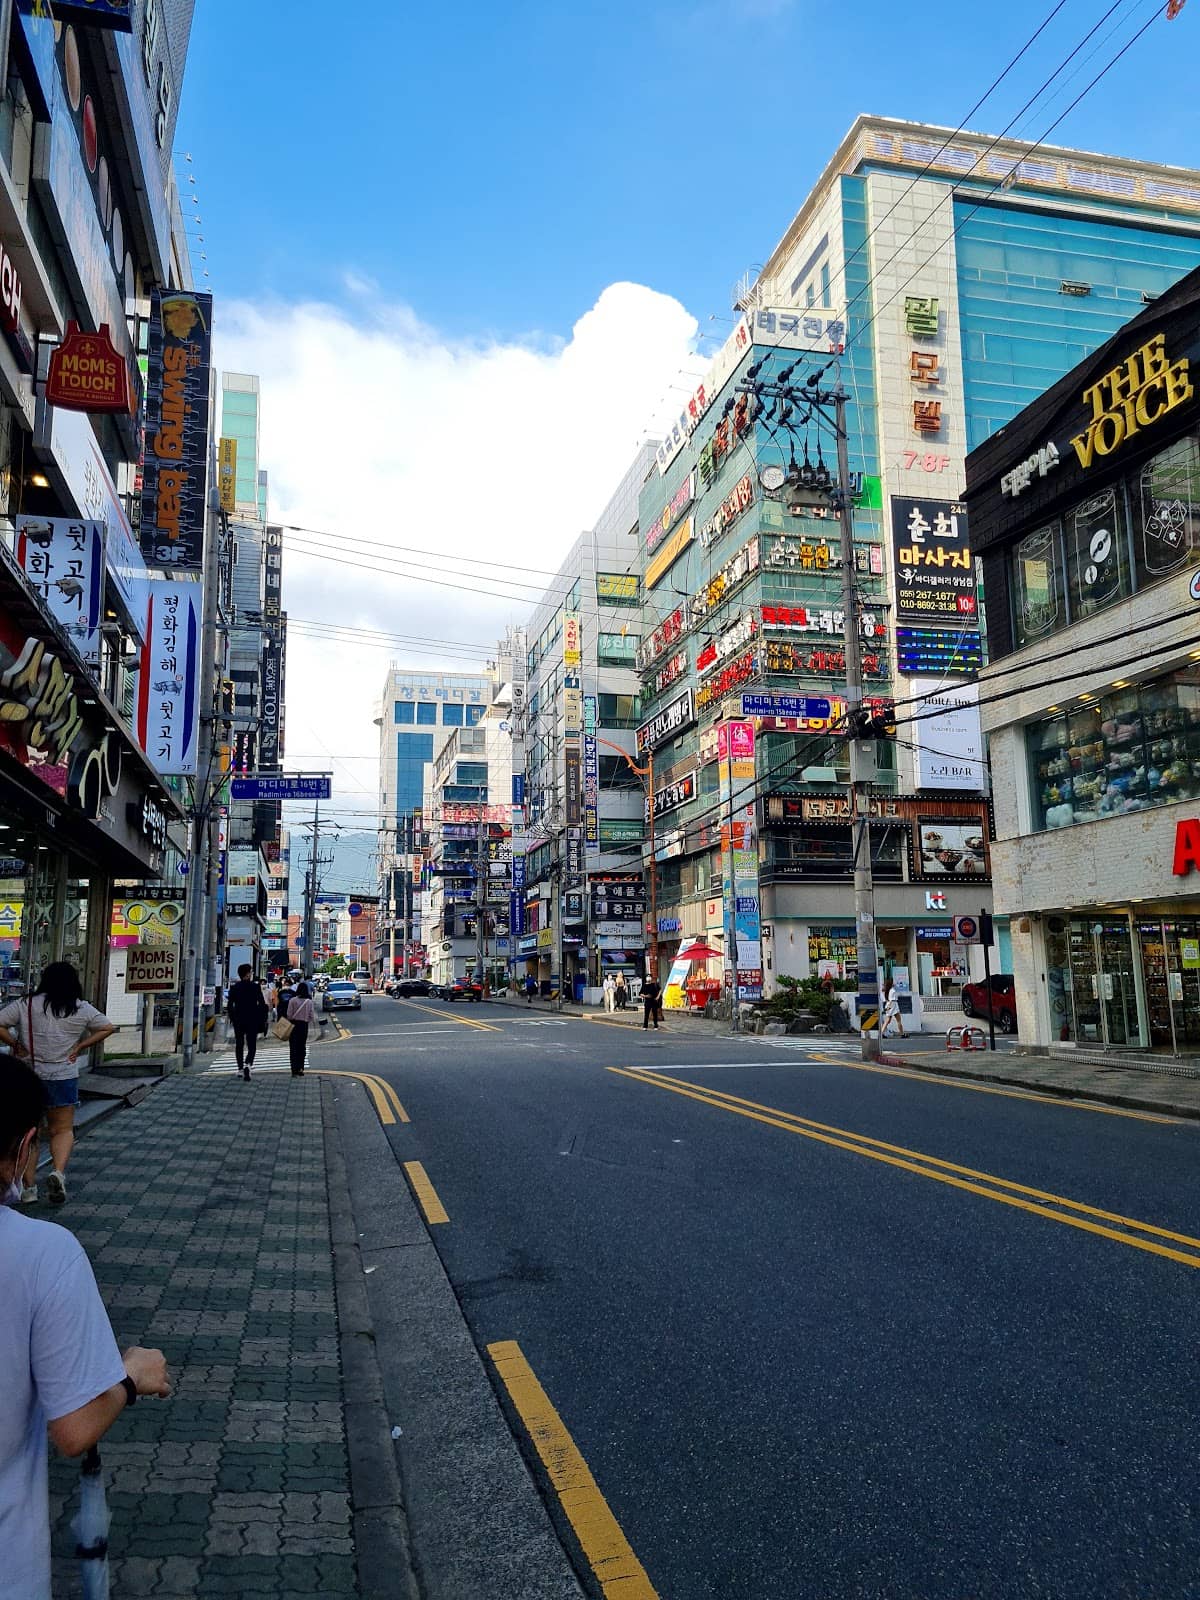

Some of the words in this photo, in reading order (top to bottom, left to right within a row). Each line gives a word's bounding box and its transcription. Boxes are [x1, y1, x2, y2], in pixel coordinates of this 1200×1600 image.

[0, 253, 22, 329] CH
[58, 371, 115, 392] TOUCH
[1083, 333, 1169, 425] THE
[153, 346, 193, 461] swing
[1069, 357, 1194, 469] VOICE
[157, 469, 189, 541] bar
[907, 507, 960, 543] 춘희
[156, 545, 187, 562] 3F
[899, 545, 971, 569] 마사지
[160, 595, 179, 676] 평화김해
[265, 658, 275, 691] ESCAPE
[264, 692, 277, 725] TOP
[157, 700, 174, 762] 뒷고기
[258, 791, 292, 799] Madimi-ro
[807, 801, 901, 818] 도쿄스이크
[925, 892, 947, 910] kt
[128, 966, 174, 980] TOUCH
[132, 950, 175, 966] MOM'S
